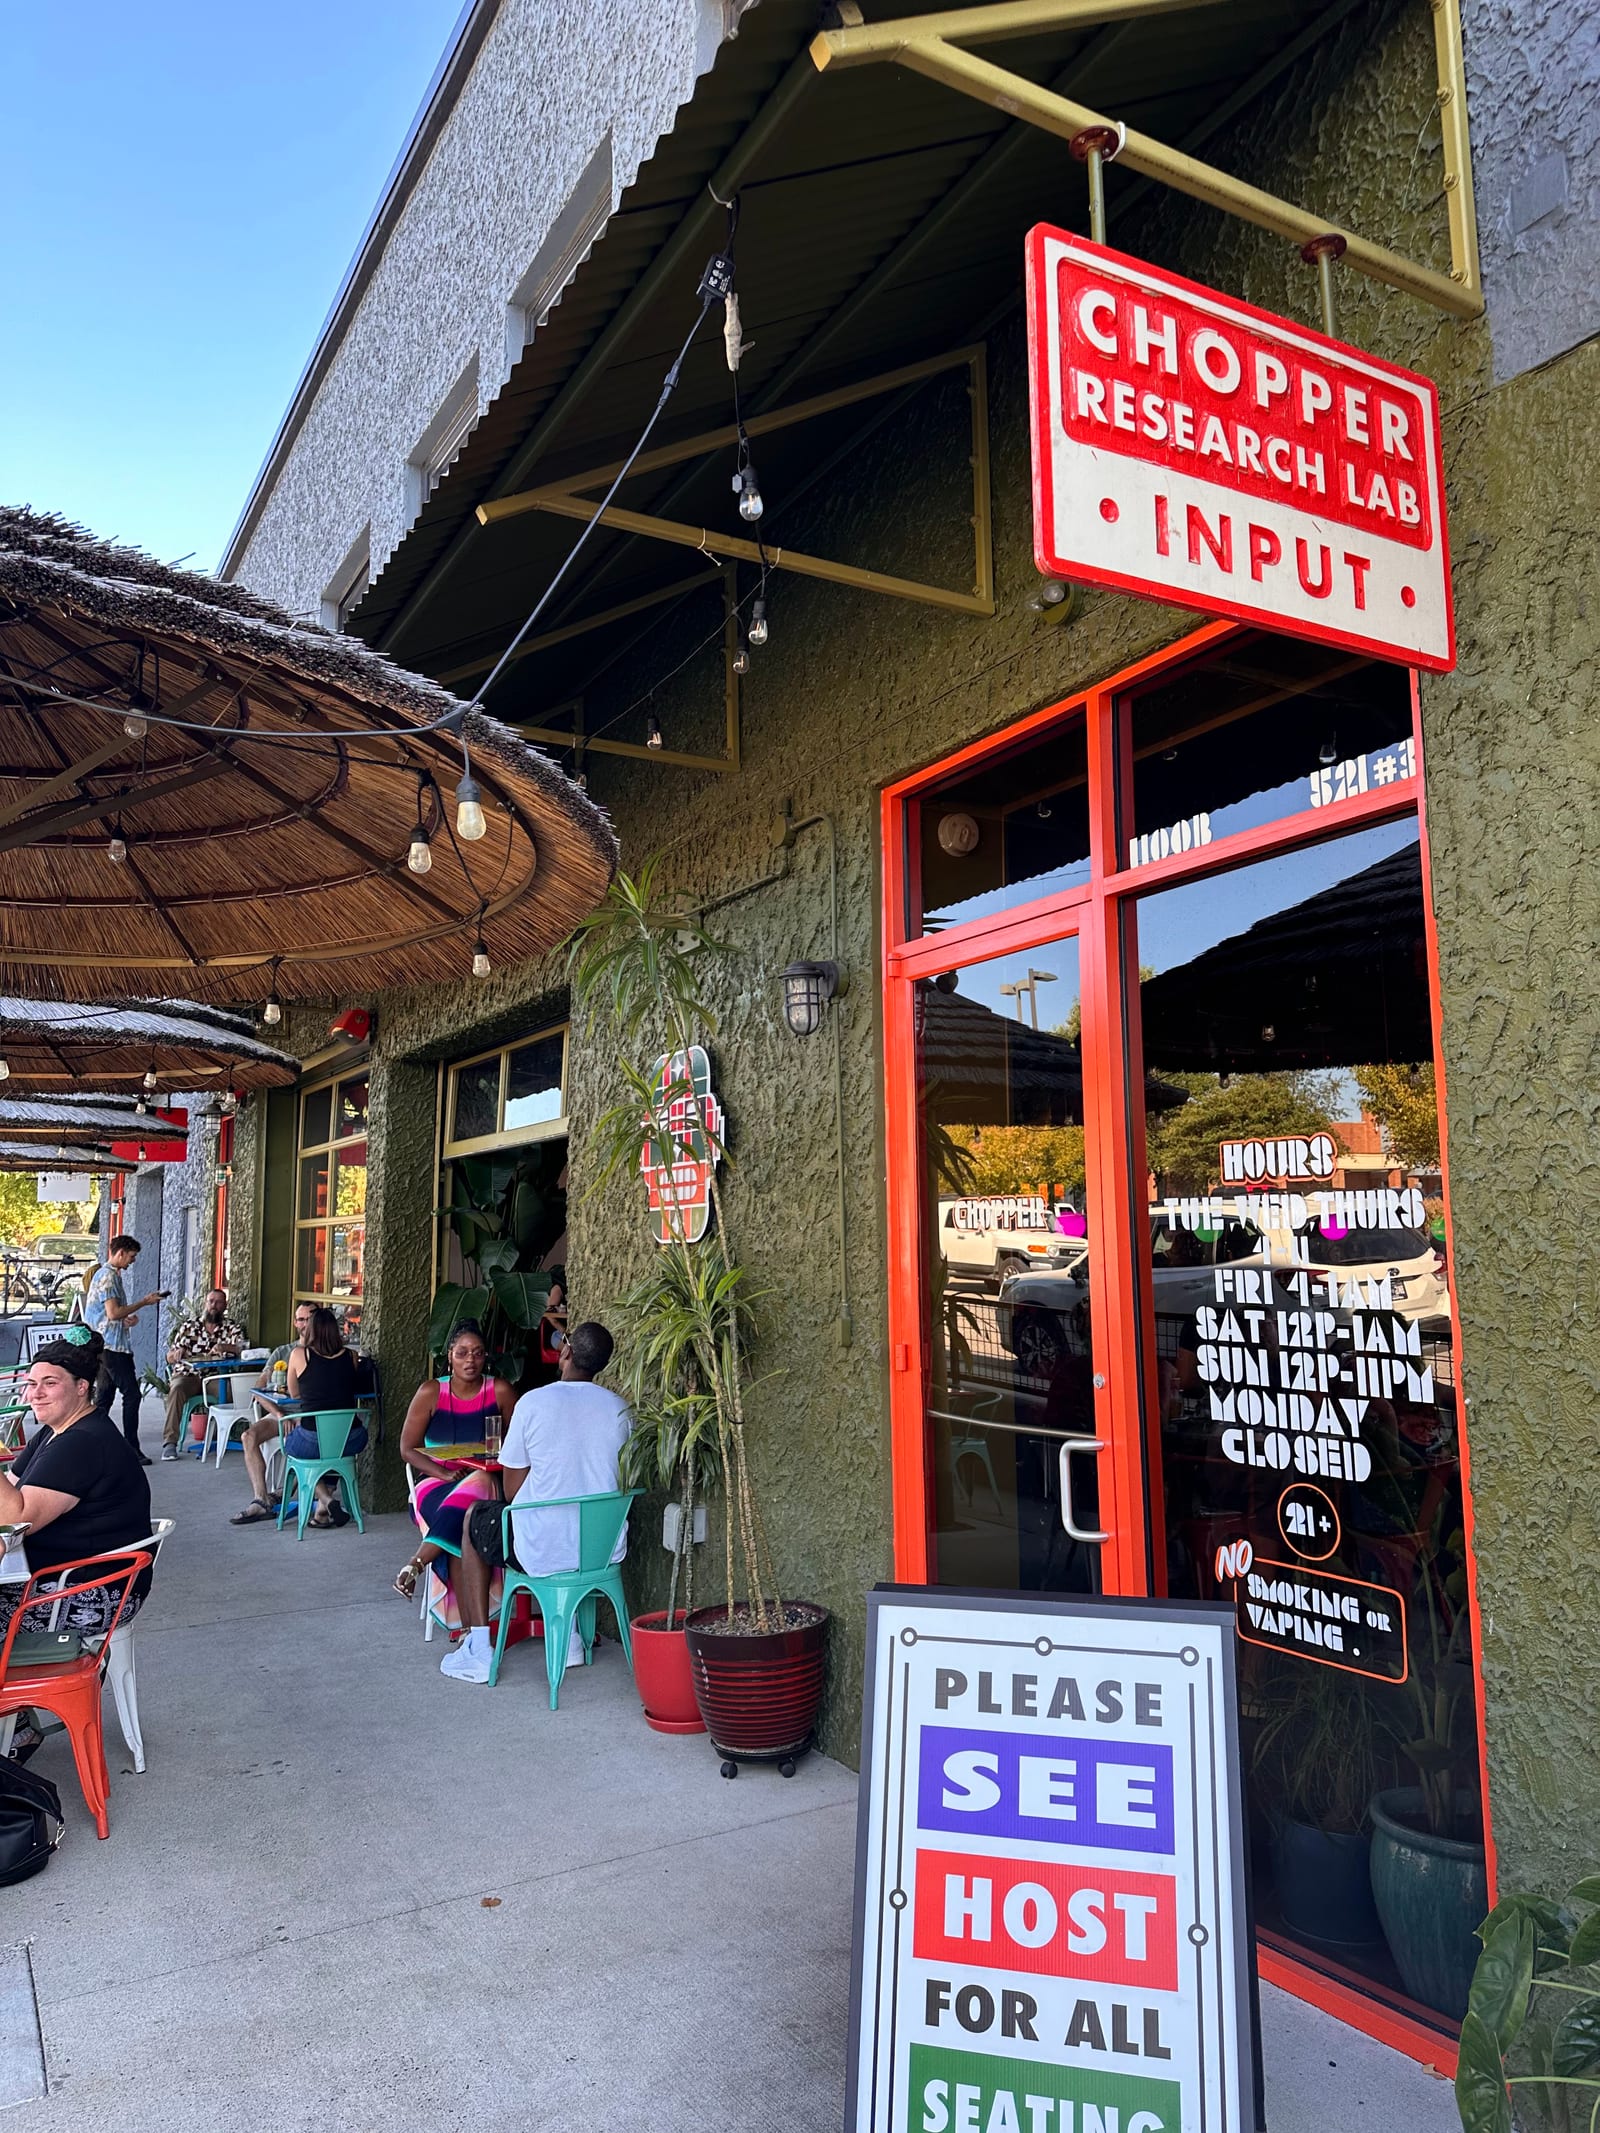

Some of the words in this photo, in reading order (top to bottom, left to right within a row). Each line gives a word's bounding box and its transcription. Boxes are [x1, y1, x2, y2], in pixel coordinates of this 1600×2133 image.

[1078, 289, 1415, 463] CHOPPER
[1075, 372, 1326, 495] RESEARCH
[1346, 461, 1421, 528] LAB
[1155, 494, 1372, 610] INPUT
[1309, 754, 1368, 808] 521
[1222, 1136, 1334, 1181] HOURS
[954, 1195, 1047, 1231] CHOPPER
[1315, 1188, 1427, 1230] THURS
[1214, 1269, 1274, 1305] FRI
[1286, 1271, 1393, 1310] 4-1AM
[1196, 1306, 1265, 1343] SAT
[1276, 1311, 1421, 1356] 12P-1AM
[1197, 1344, 1270, 1387] SUN
[1279, 1351, 1434, 1404] 12P-11PM
[1209, 1385, 1370, 1438] MONDAY
[1222, 1428, 1372, 1482] CLOSED
[1285, 1502, 1331, 1537] 21+
[1216, 1539, 1253, 1583] NO
[1247, 1573, 1360, 1624] SMOKING
[934, 1667, 1164, 1727] PLEASE
[942, 1750, 1157, 1829] SEE
[943, 1873, 1157, 1961] HOST
[924, 1978, 1040, 2042] FOR
[1064, 1998, 1172, 2060] ALL
